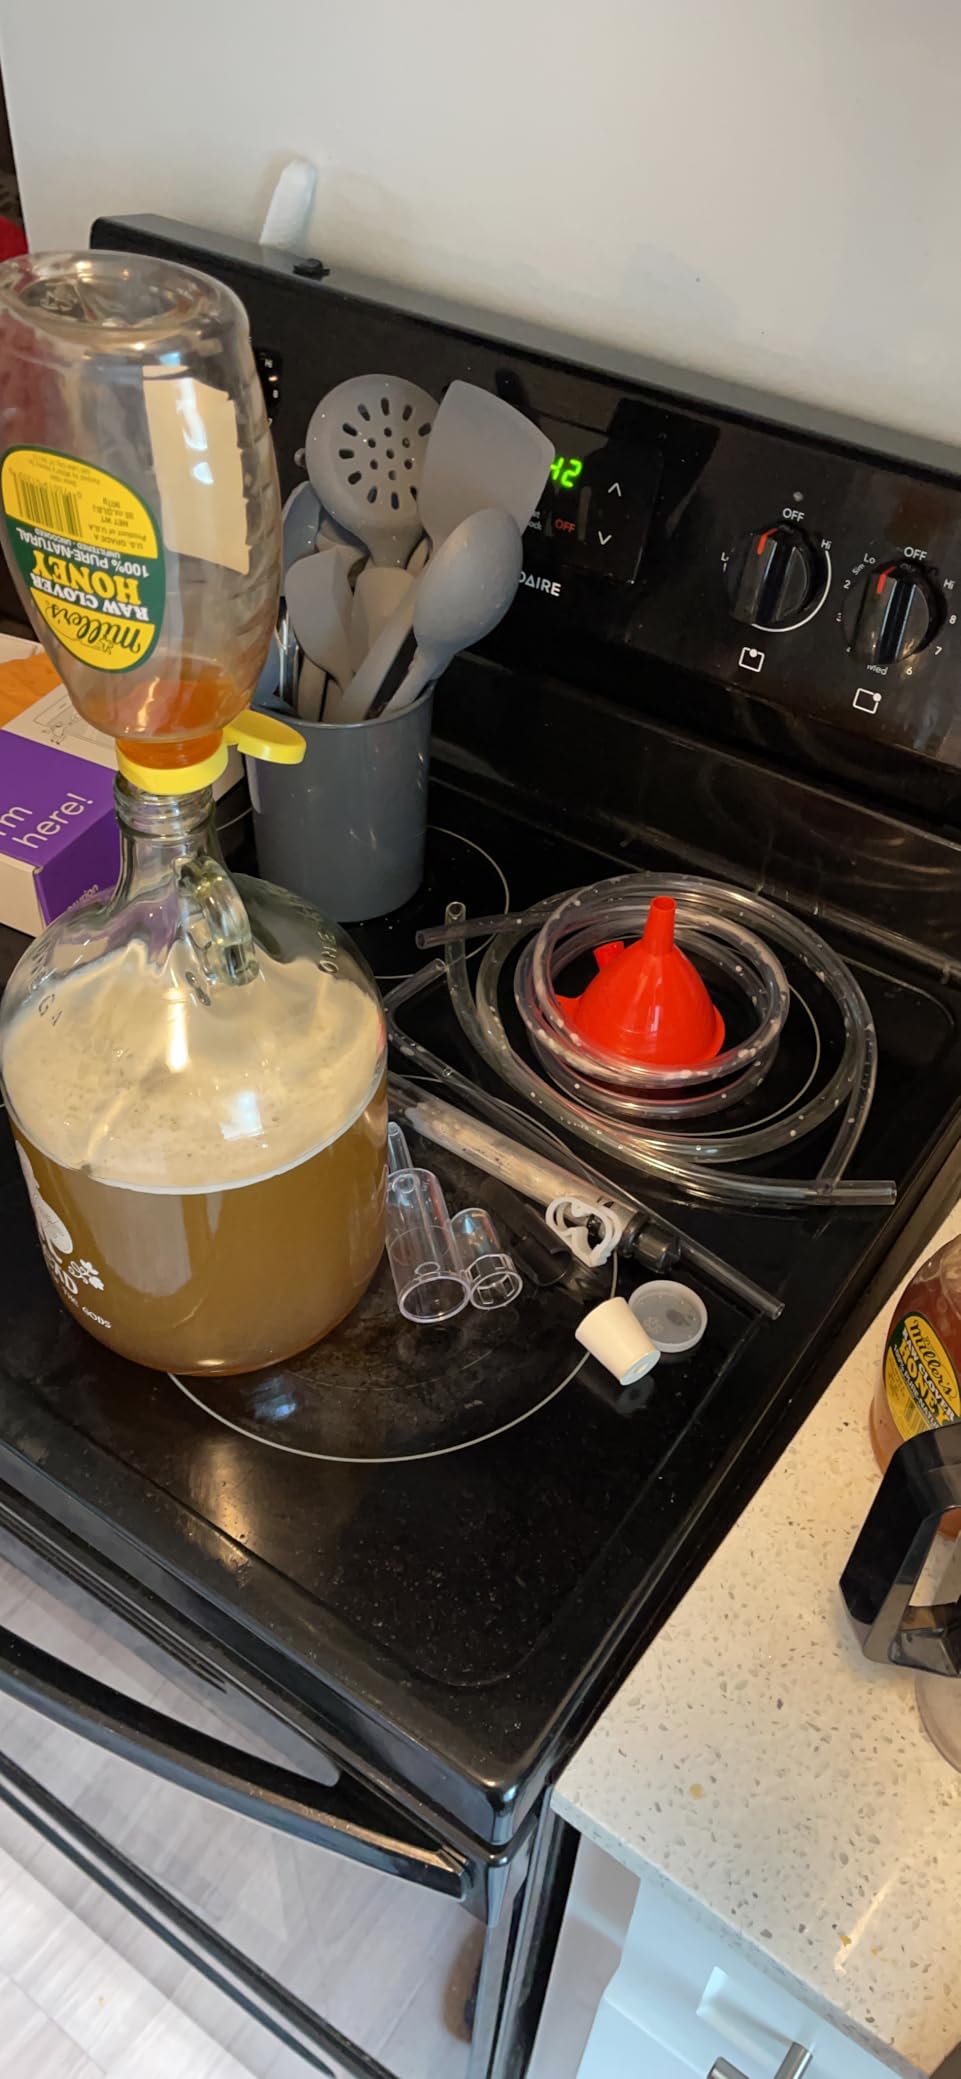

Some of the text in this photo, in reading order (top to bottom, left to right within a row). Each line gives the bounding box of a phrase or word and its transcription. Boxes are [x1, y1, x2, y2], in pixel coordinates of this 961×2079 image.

[782, 507, 805, 522] OFF
[554, 518, 576, 533] OFF
[820, 539, 832, 550] Hi
[16, 527, 149, 578] 100% PURE-NATURAL
[863, 552, 876, 565] Lo
[903, 546, 928, 561] OFF
[32, 549, 142, 606] HONEY
[843, 579, 851, 590] 2
[943, 578, 956, 590] Hi
[30, 572, 149, 621] RAW CLOVER
[949, 614, 957, 625] 8
[934, 645, 942, 656] 7
[905, 666, 913, 676] 6
[12, 792, 94, 849] here!
[900, 1339, 950, 1426] HONEY
[918, 1361, 955, 1422] CLOVER
